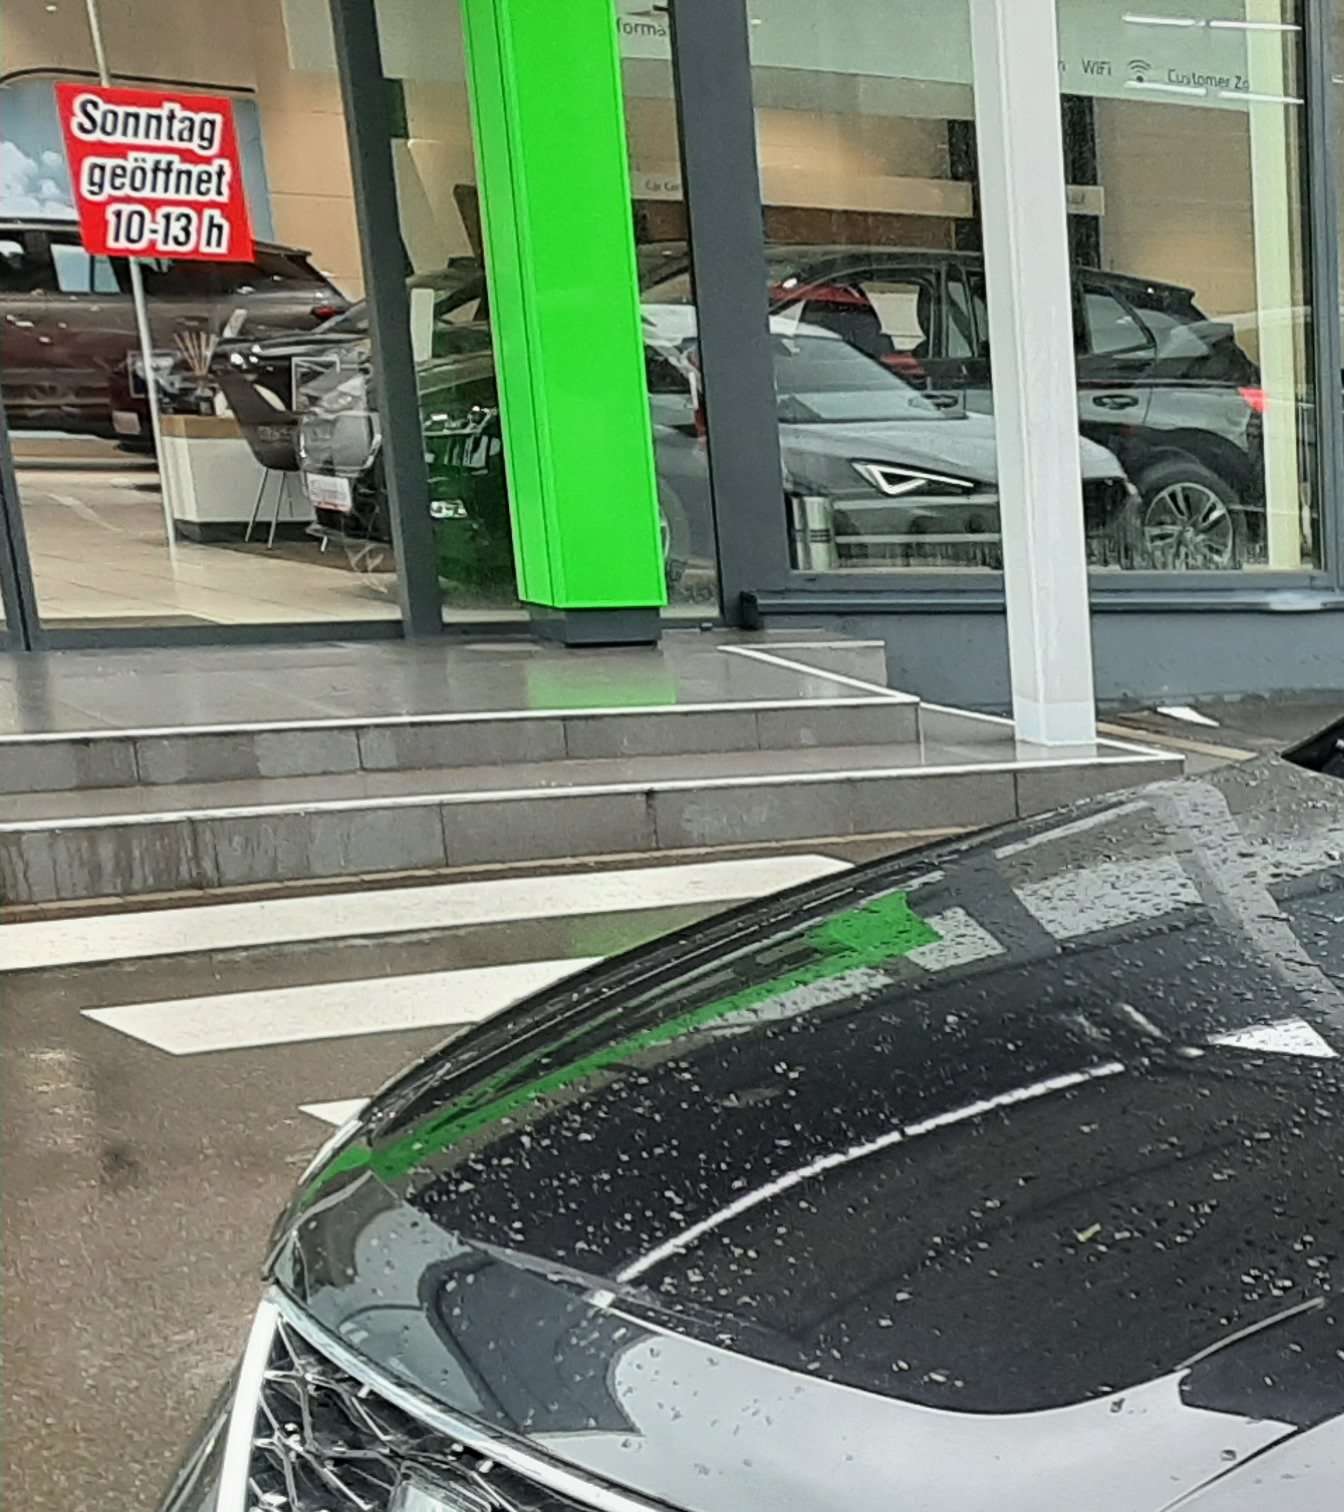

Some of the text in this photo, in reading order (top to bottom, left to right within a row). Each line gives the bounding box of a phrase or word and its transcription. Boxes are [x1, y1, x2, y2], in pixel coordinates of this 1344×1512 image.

[1081, 58, 1112, 76] WiFi
[1167, 69, 1230, 88] Customer
[76, 98, 217, 151] Sonntag
[86, 157, 226, 197] geöffnet
[112, 208, 225, 249] 10-13 h
